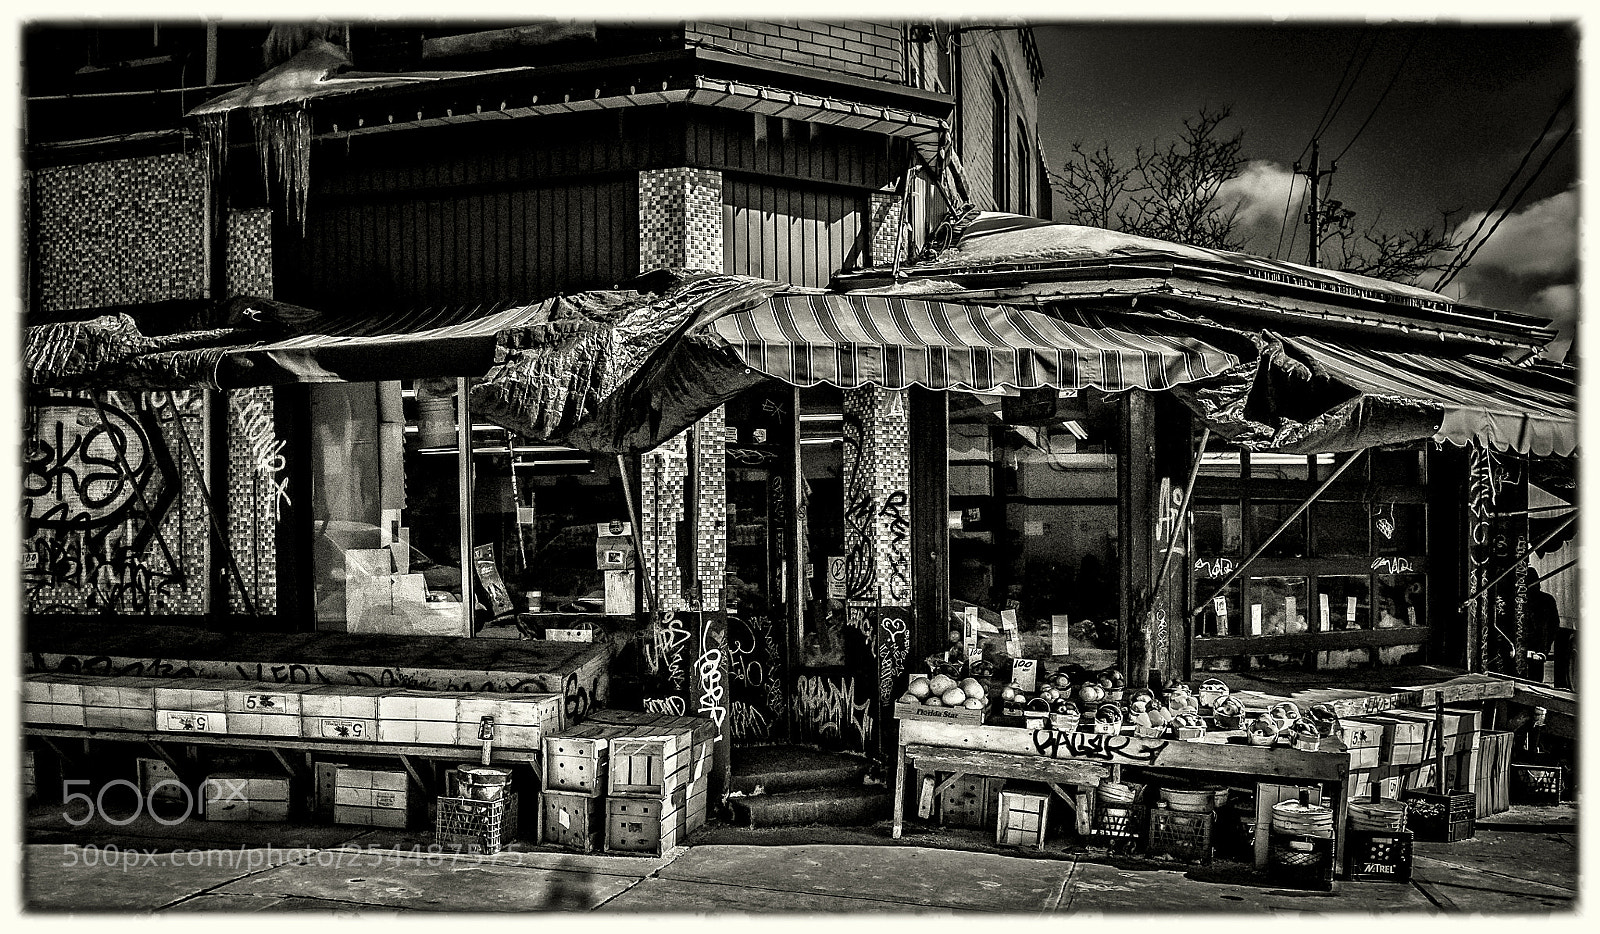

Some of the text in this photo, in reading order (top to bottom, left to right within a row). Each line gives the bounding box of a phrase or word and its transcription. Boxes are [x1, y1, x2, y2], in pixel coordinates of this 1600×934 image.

[1013, 659, 1033, 669] 100
[246, 695, 257, 710] 5
[196, 716, 207, 731] 5
[353, 723, 363, 737] 5
[1352, 731, 1359, 745] 5
